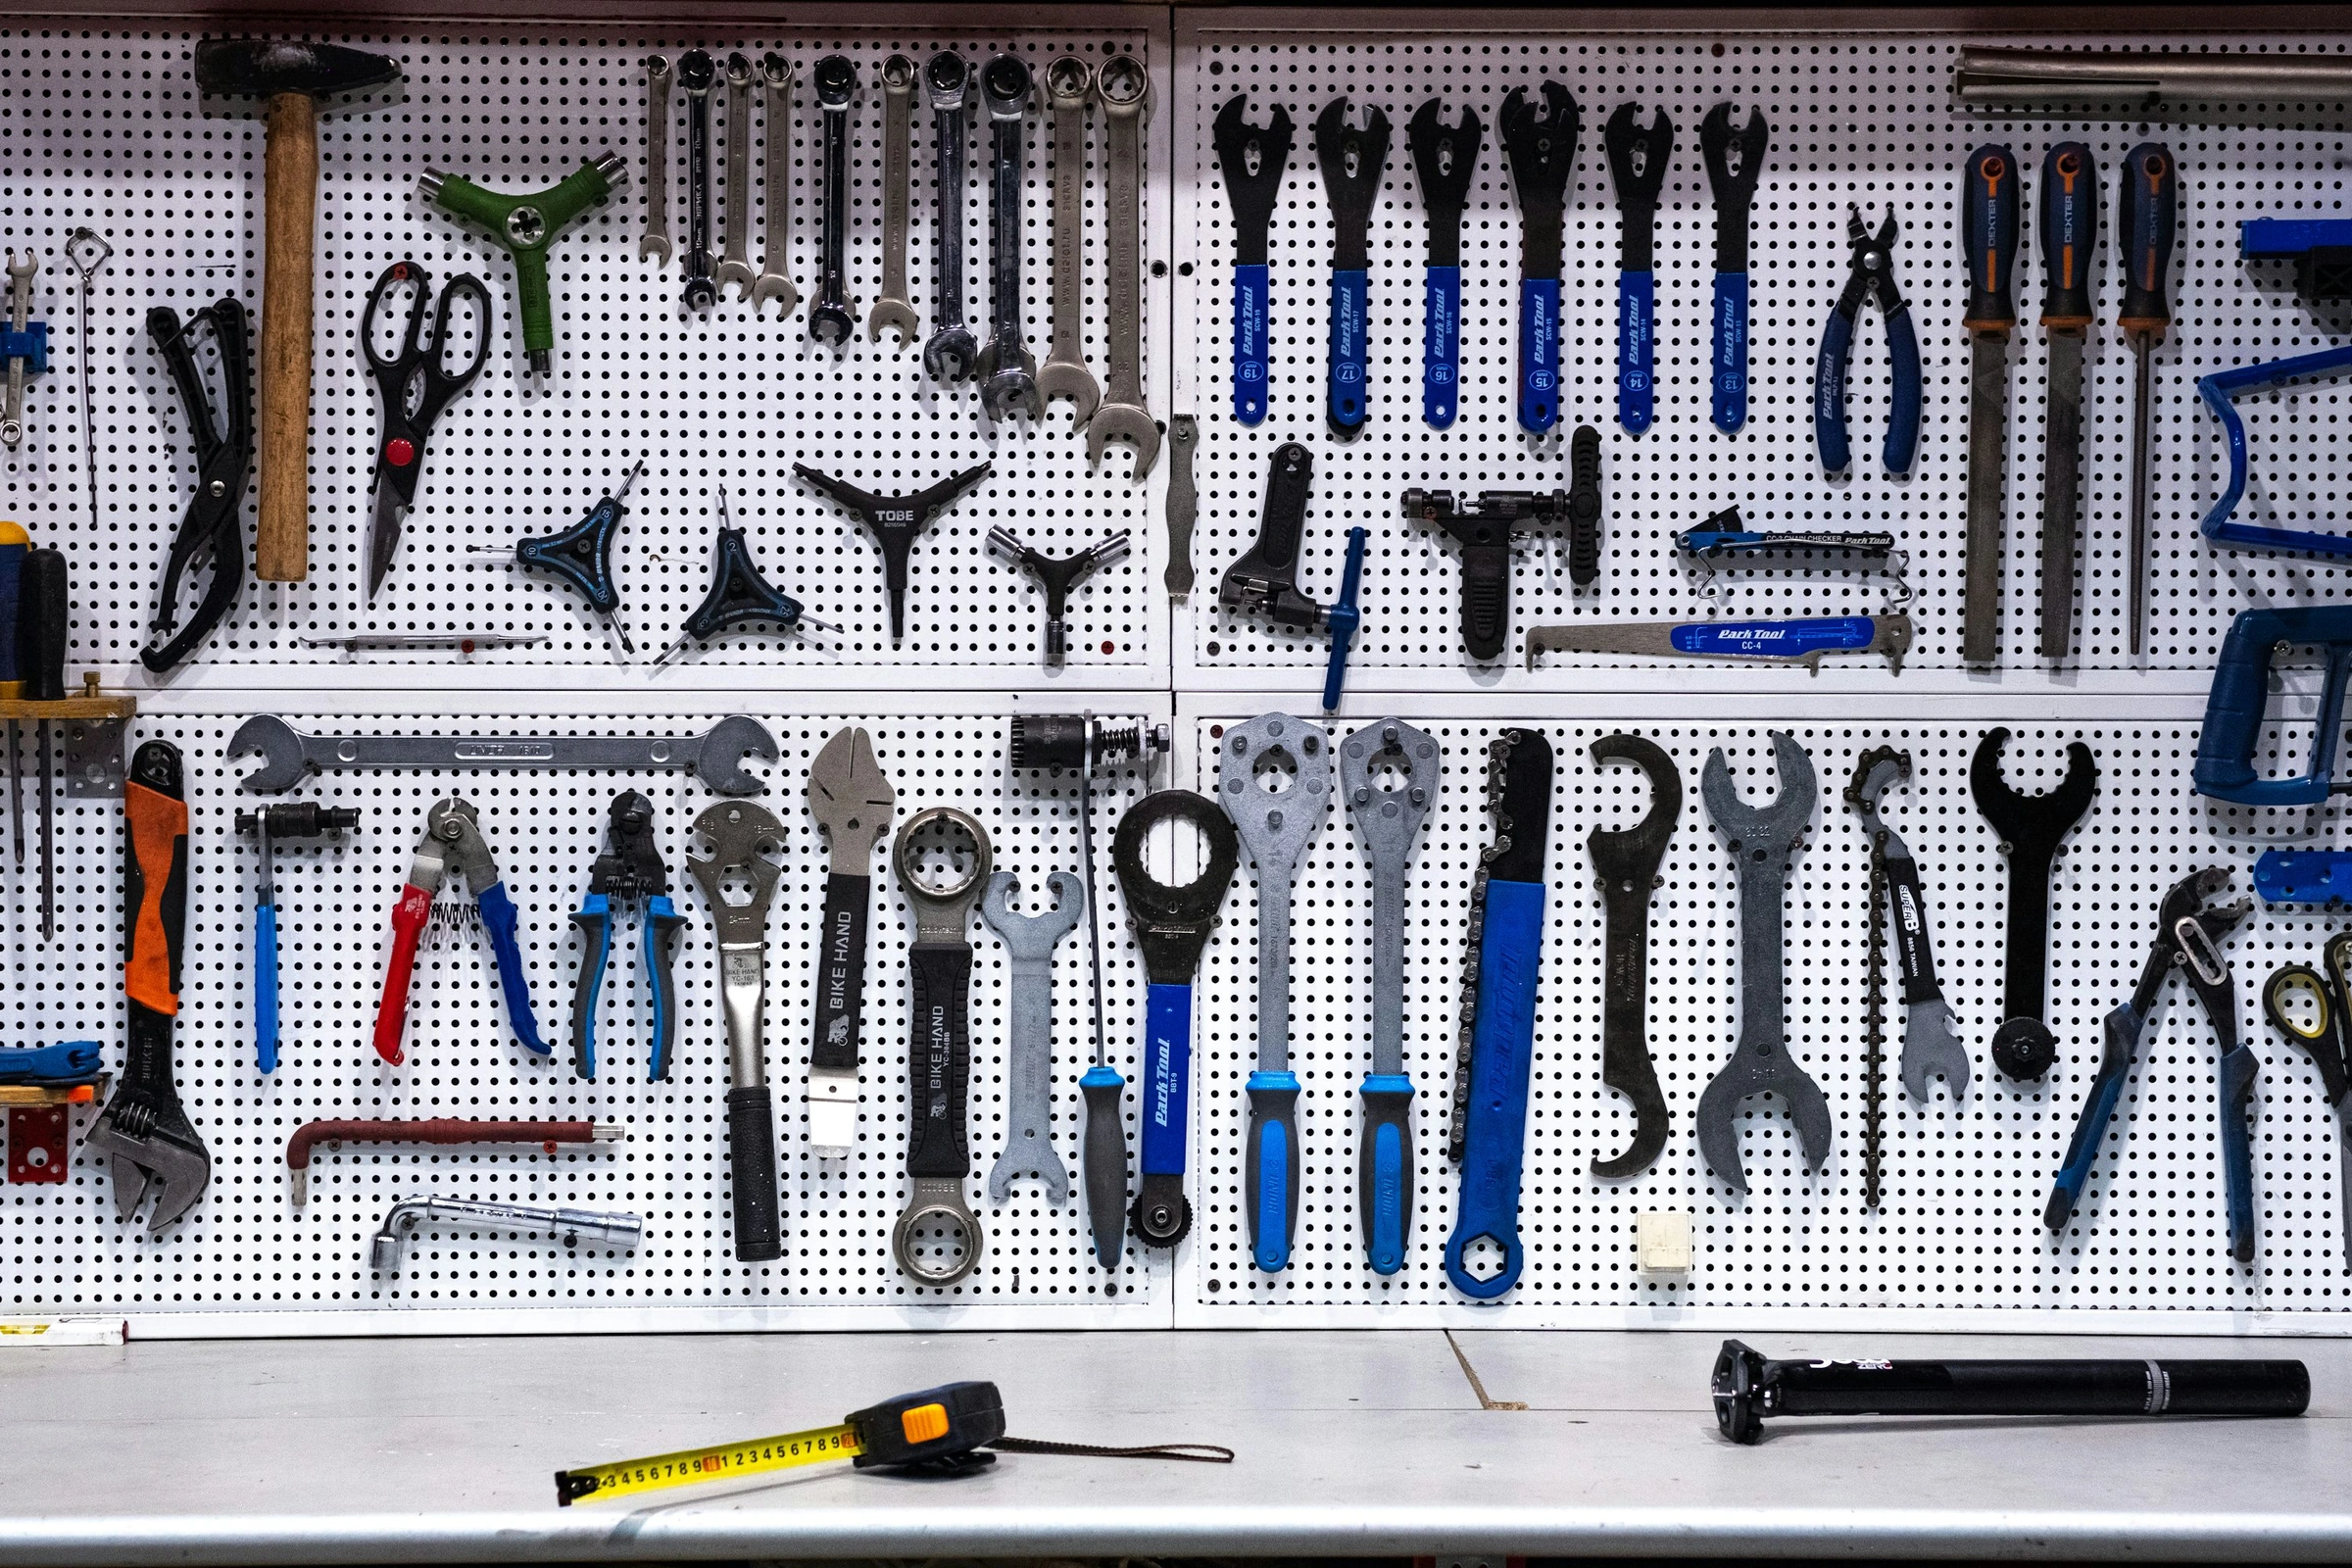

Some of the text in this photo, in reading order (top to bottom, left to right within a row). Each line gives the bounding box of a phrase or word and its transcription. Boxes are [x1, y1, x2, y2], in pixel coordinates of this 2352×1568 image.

[1988, 199, 1997, 247] DEXTER
[2064, 196, 2073, 243] DEXTER
[2149, 198, 2158, 245] DEXTER
[1243, 285, 1253, 356] Park Tool
[1341, 286, 1351, 357] Park Tool
[1434, 287, 1445, 358] Park Tool
[1534, 294, 1544, 365] Park Tool
[1629, 294, 1640, 366] Park Tool
[1723, 296, 1735, 367] Park Tool
[1244, 368, 1257, 379] 19
[1342, 369, 1355, 380] 17
[1435, 370, 1448, 381] 16
[1536, 377, 1548, 387] 15
[1630, 378, 1643, 388] 14
[1725, 379, 1738, 390] 13
[601, 510, 611, 518] 15
[875, 510, 914, 521] TOBE
[527, 547, 537, 556] 10
[728, 542, 737, 552] 2
[1718, 629, 1786, 640] Park Tool
[1741, 641, 1762, 650] CC-4
[829, 911, 852, 1009] BIKE HAND
[1910, 952, 1919, 977] TAIWAN
[930, 1005, 944, 1089] BIKE HAND
[1155, 1037, 1171, 1128] Park Tool
[608, 1475, 616, 1488] 3
[621, 1472, 630, 1485] 4
[636, 1470, 645, 1483] 5
[650, 1467, 659, 1480] 6
[664, 1465, 672, 1477] 7
[679, 1462, 688, 1475] 8
[693, 1460, 702, 1473] 9
[721, 1455, 728, 1467] 1
[736, 1453, 744, 1465] 2
[750, 1450, 758, 1463] 3
[763, 1448, 771, 1460] 4
[777, 1446, 785, 1457] 5
[791, 1444, 799, 1455] 6
[805, 1441, 812, 1453] 7
[818, 1439, 826, 1451] 8
[831, 1437, 840, 1448] 9
